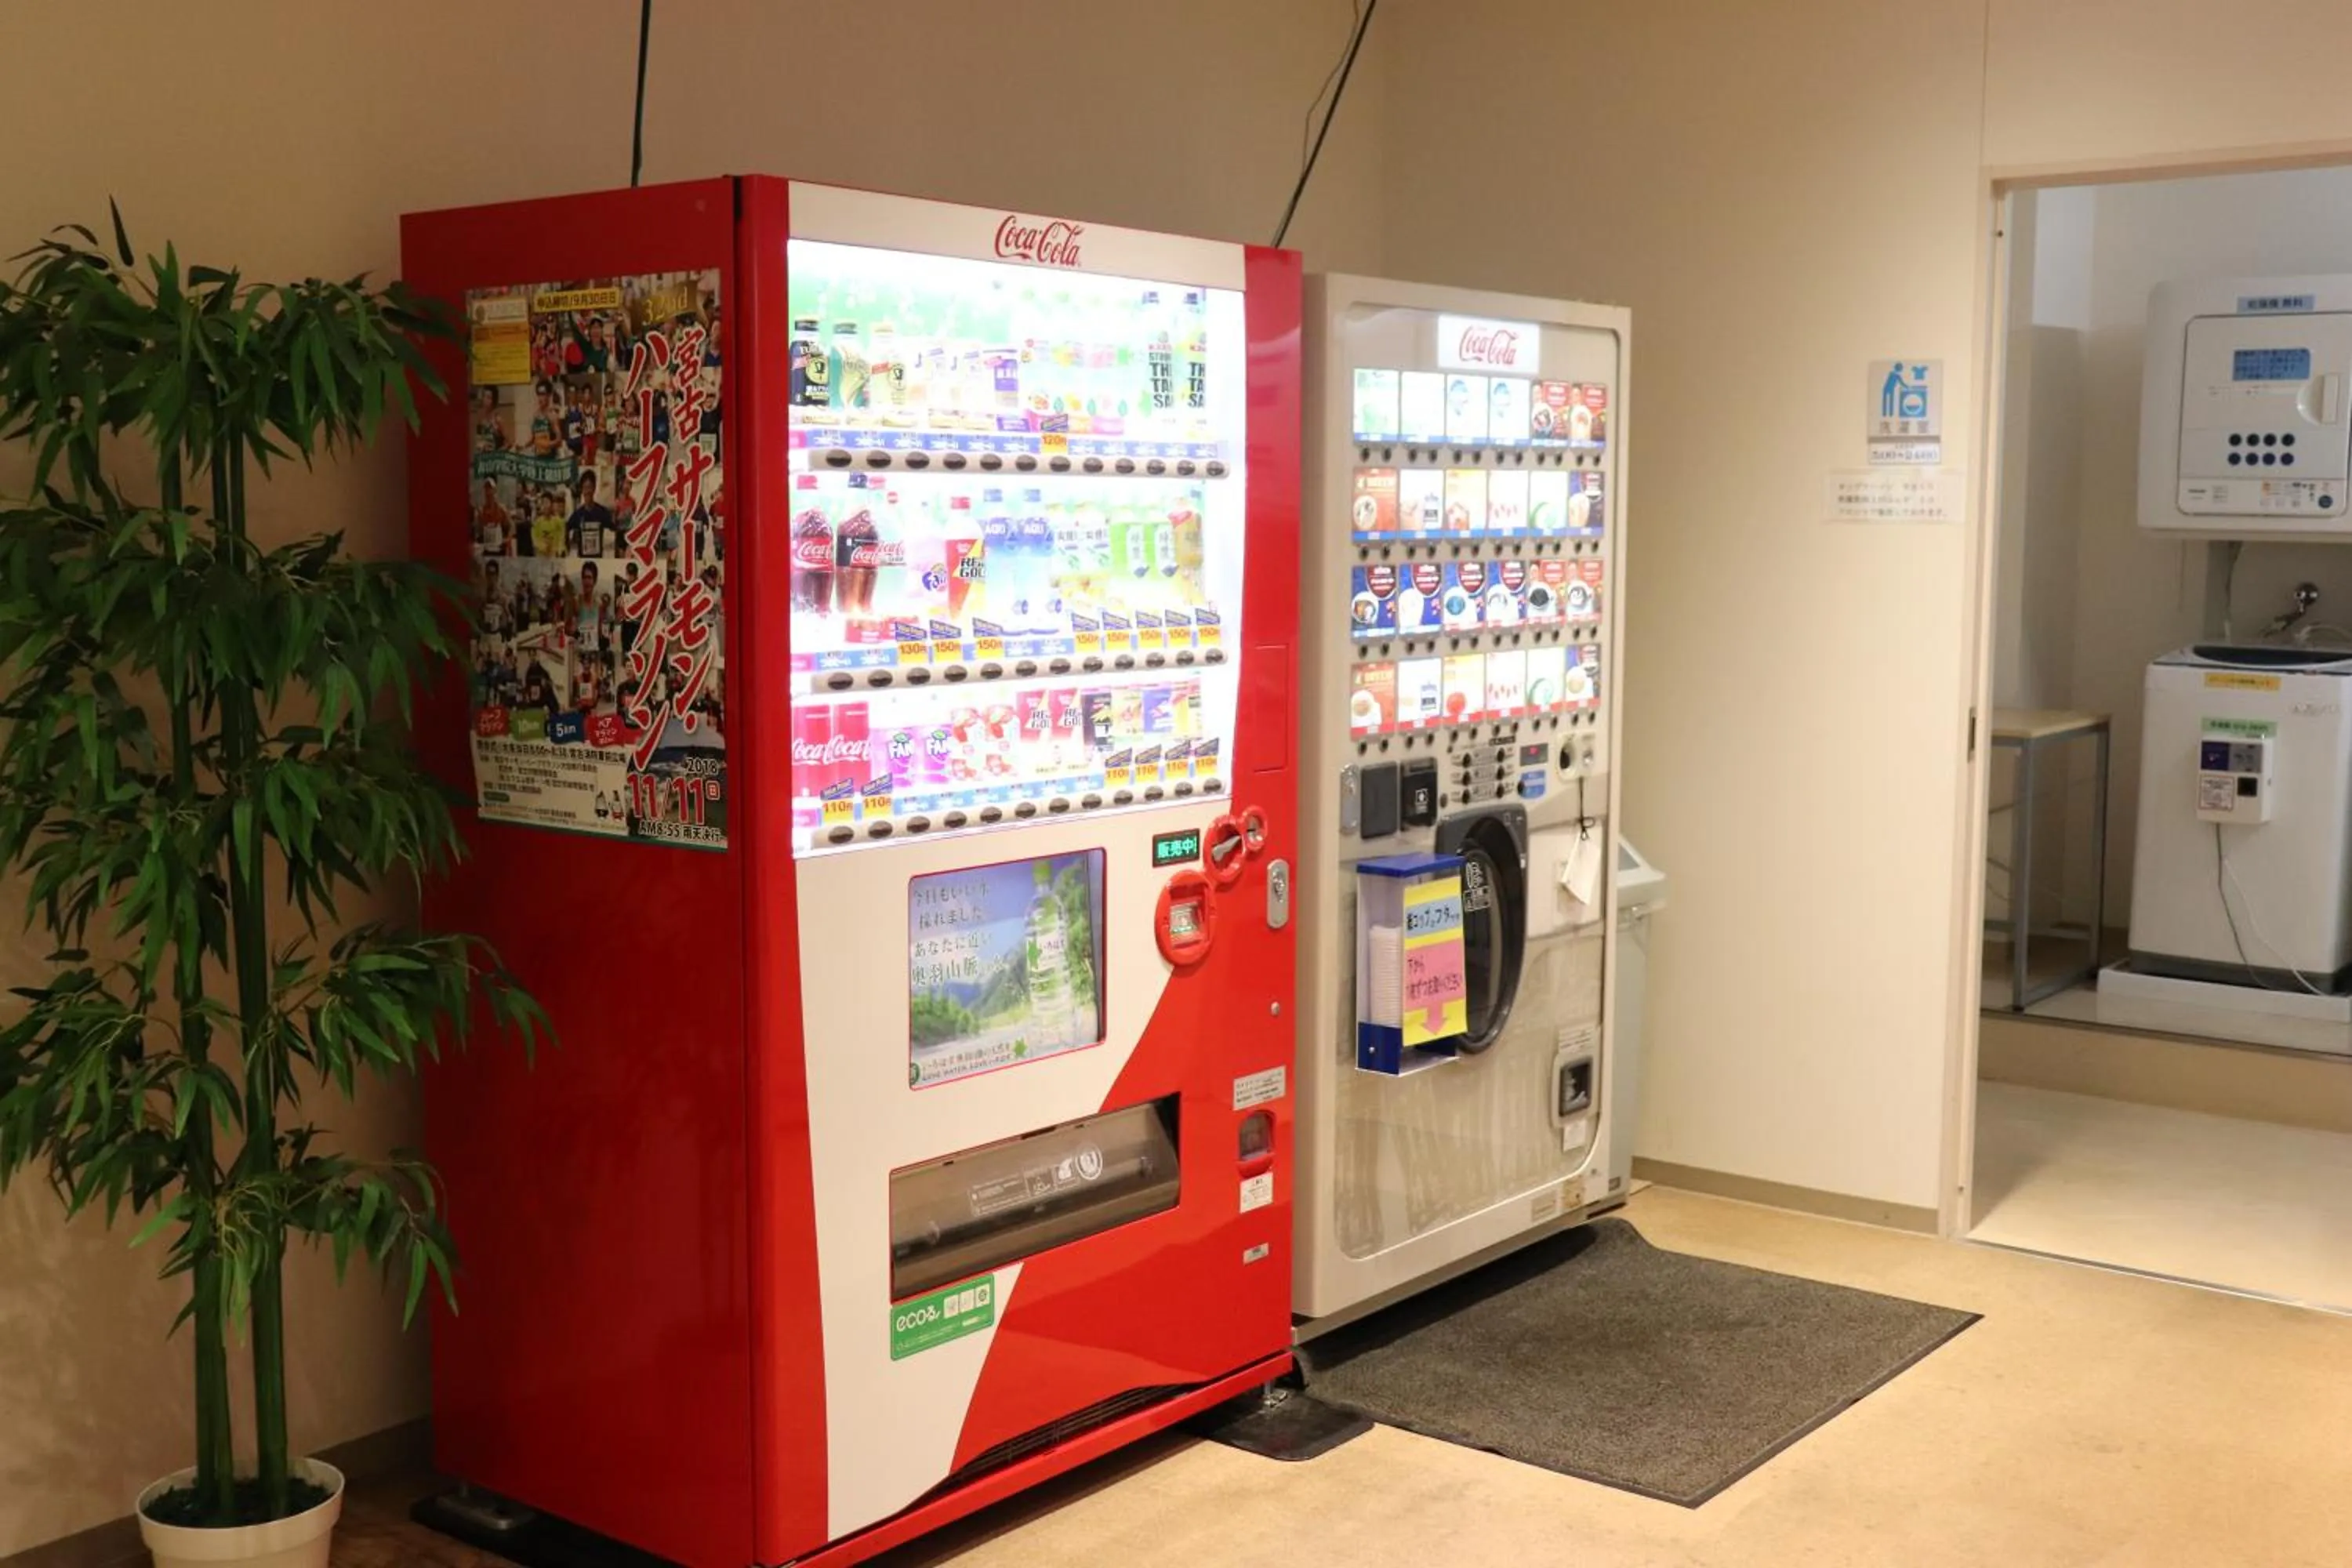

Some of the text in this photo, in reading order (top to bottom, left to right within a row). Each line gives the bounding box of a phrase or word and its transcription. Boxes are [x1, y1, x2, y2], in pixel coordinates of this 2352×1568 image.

[625, 330, 670, 771] ハーフマラソン
[685, 757, 718, 775] 2018
